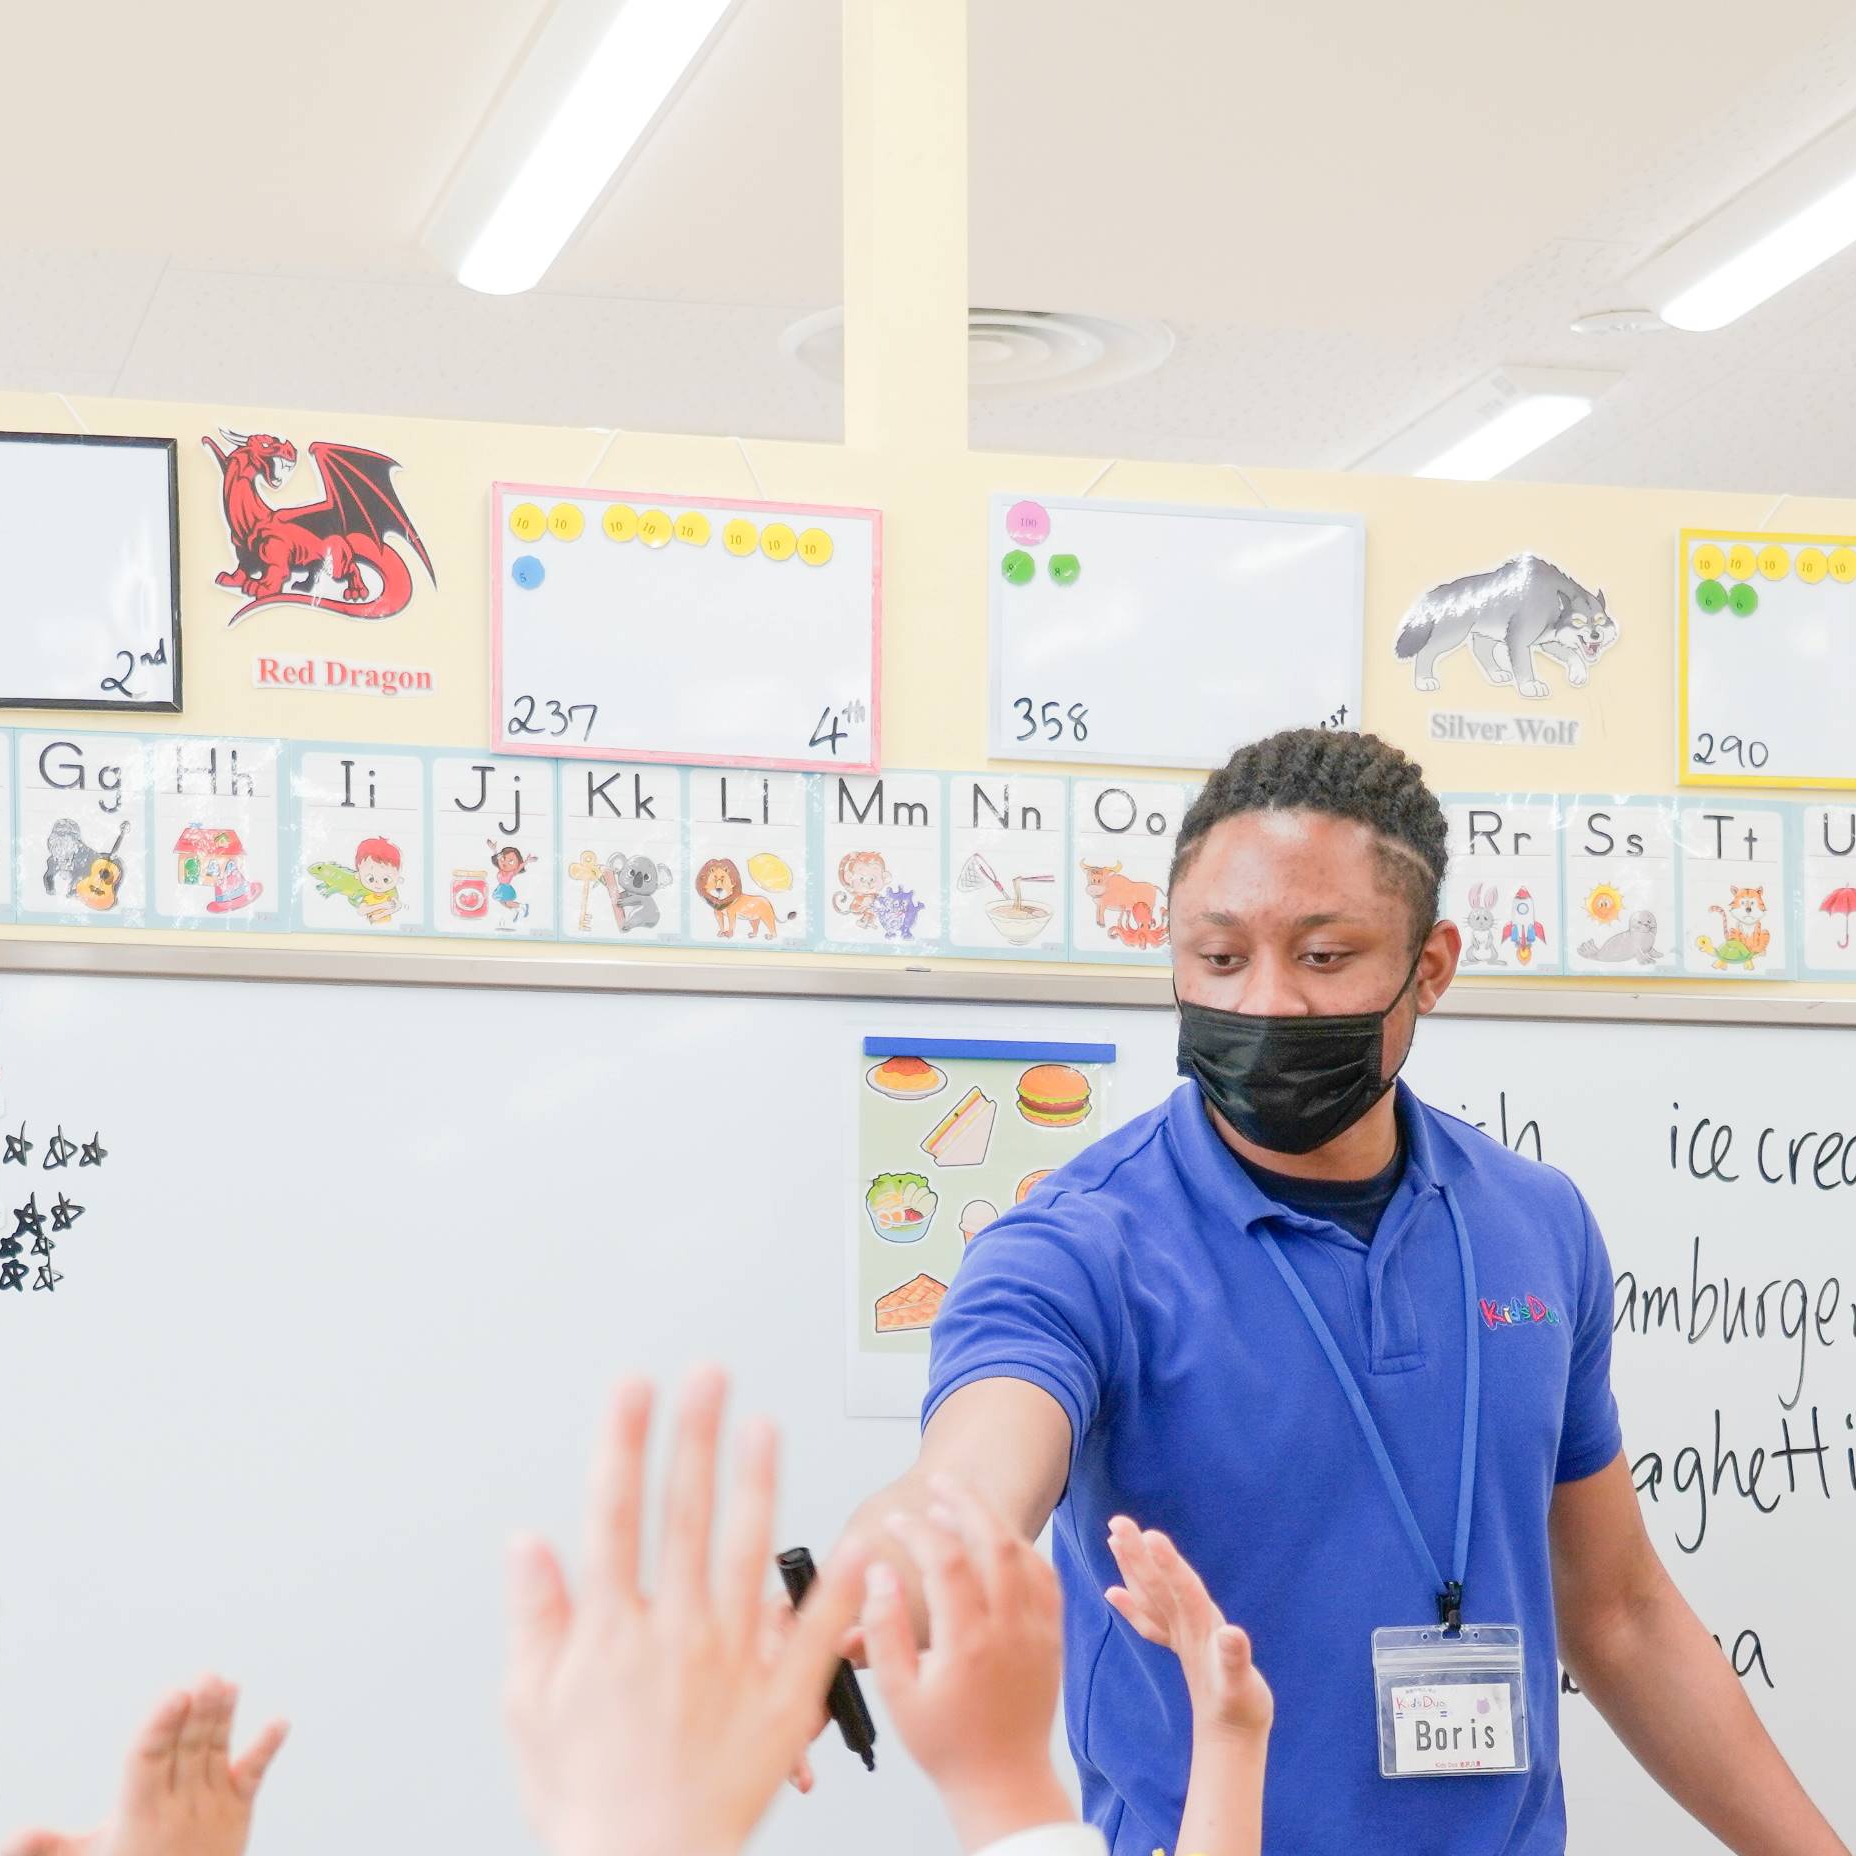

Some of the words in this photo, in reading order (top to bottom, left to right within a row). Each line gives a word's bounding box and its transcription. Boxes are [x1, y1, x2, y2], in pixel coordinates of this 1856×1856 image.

[257, 656, 315, 688] Red
[326, 660, 432, 694] Dragon
[507, 694, 599, 742] 237
[1013, 697, 1090, 742] 358
[1431, 712, 1506, 743] Silver
[1512, 717, 1579, 747] Wolf
[1693, 732, 1769, 768] 290
[1668, 1102, 1739, 1182] ice
[1415, 1718, 1495, 1752] Boris
